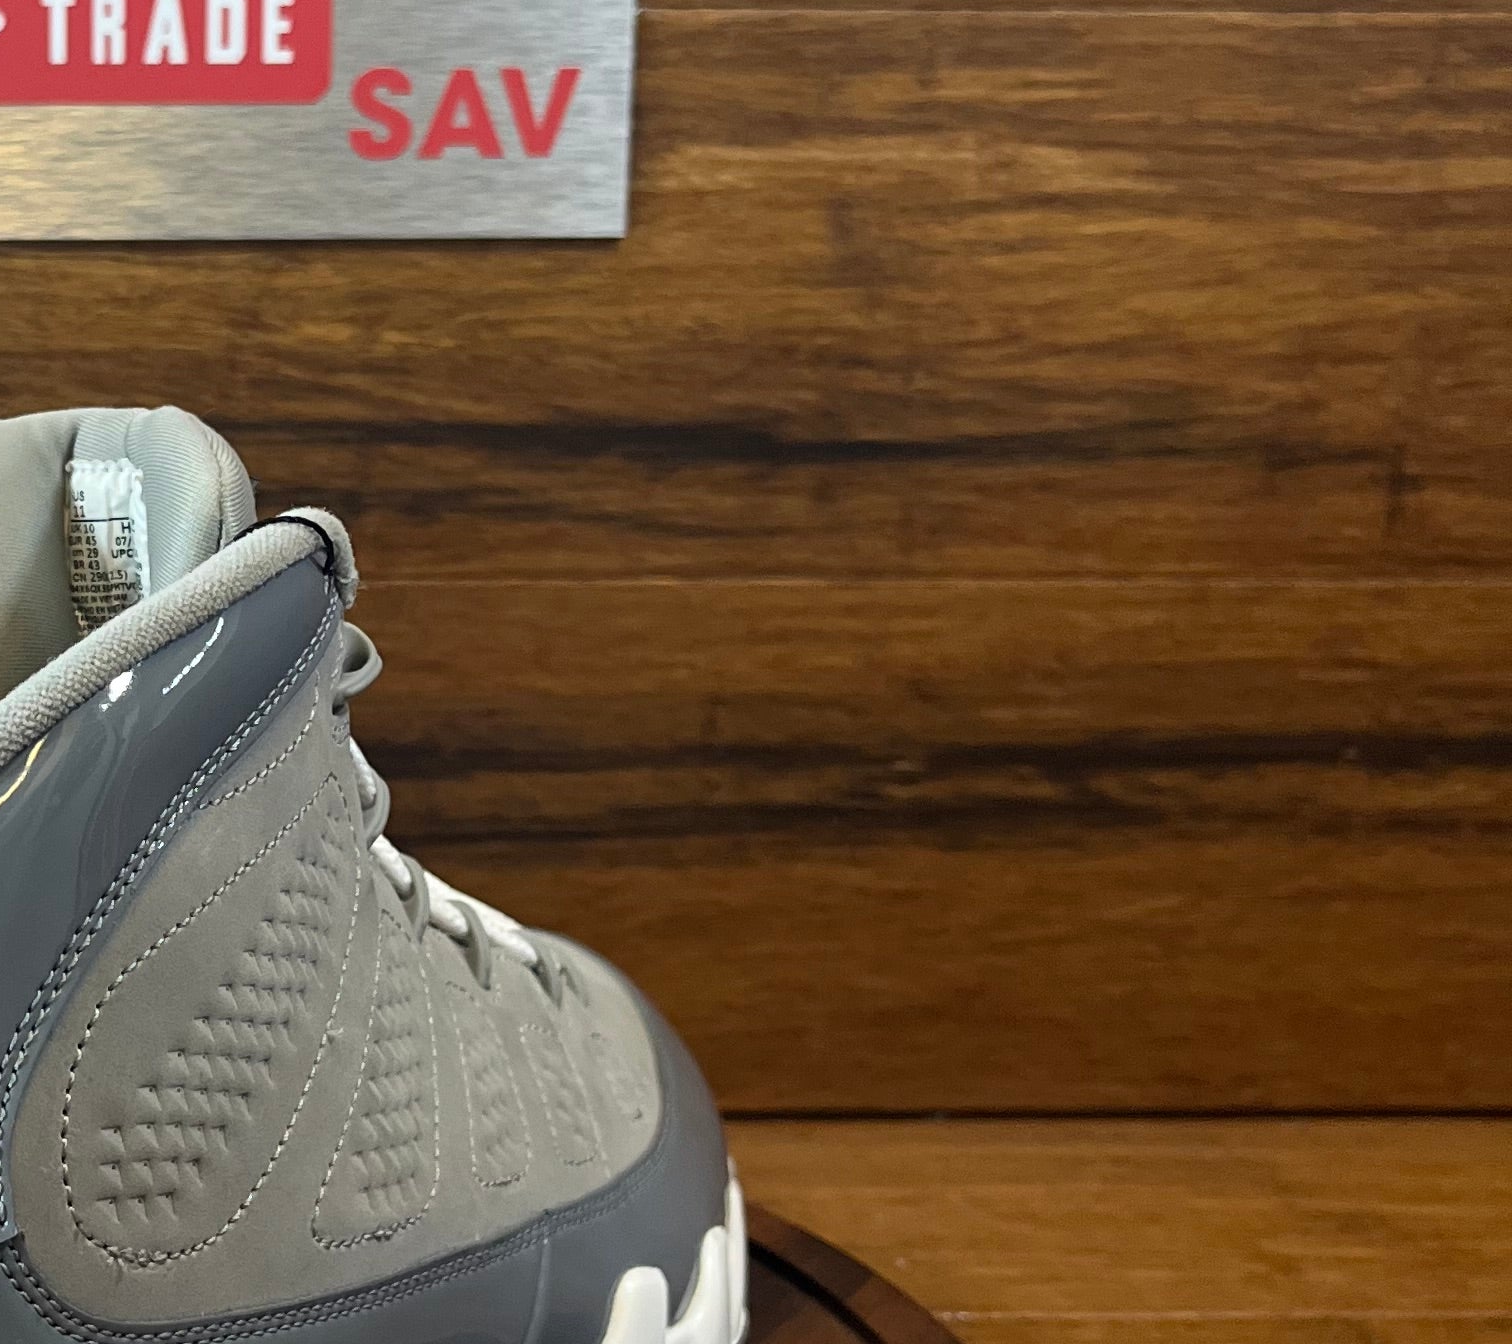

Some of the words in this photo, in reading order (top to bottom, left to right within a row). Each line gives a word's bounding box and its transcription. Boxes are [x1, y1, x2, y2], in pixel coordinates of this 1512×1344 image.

[348, 67, 580, 160] SAV
[71, 490, 85, 502] US
[73, 505, 86, 518] 11
[84, 523, 95, 535] 10
[85, 536, 98, 547] 45
[87, 548, 99, 559] 29
[88, 560, 100, 571] 43
[72, 572, 87, 583] CN
